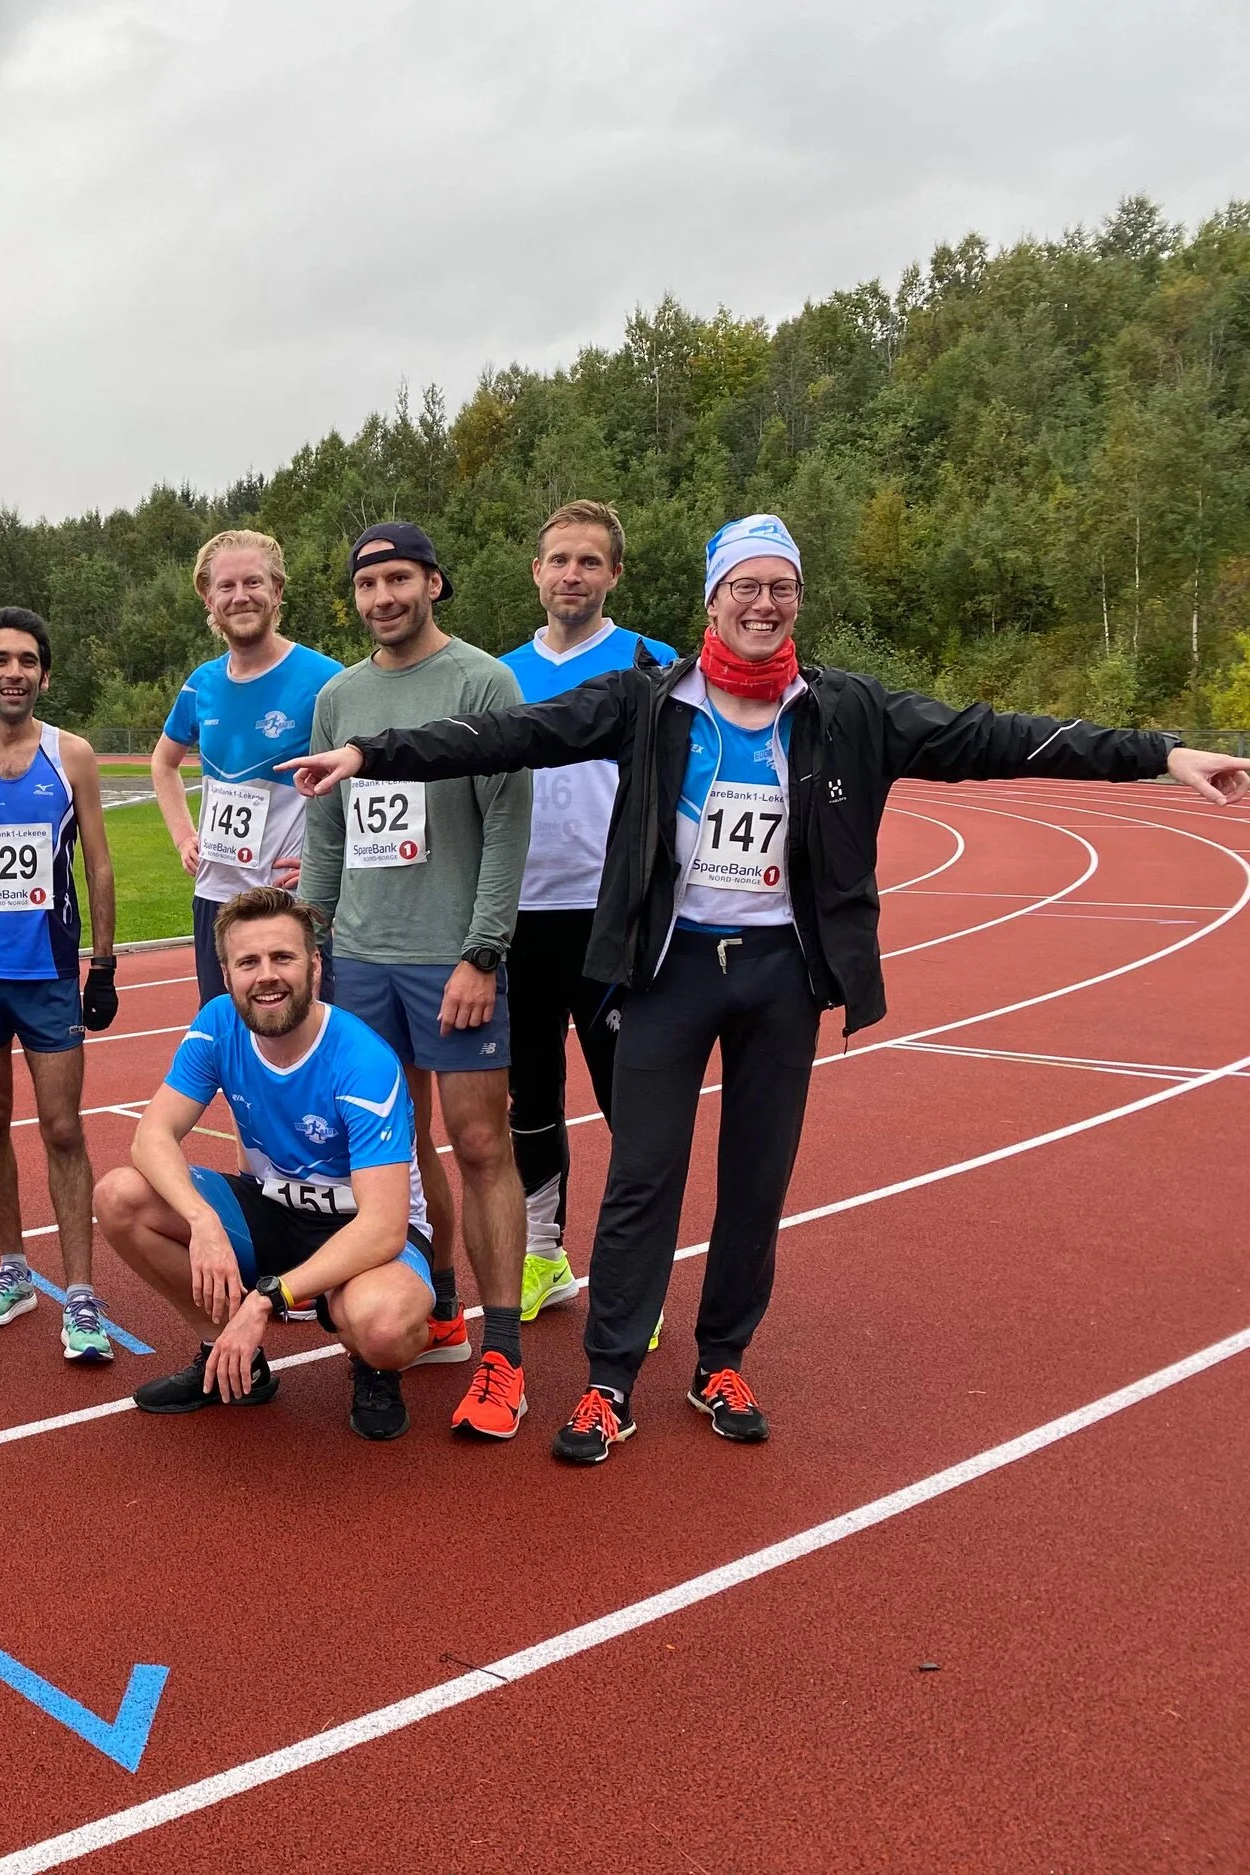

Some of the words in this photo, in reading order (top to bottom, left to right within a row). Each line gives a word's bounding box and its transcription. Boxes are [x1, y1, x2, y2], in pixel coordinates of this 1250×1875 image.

[535, 773, 572, 811] 46
[710, 790, 785, 803] areBank1-Leke
[210, 801, 252, 839] 143
[353, 793, 409, 834] 152
[707, 808, 783, 854] 147
[353, 842, 397, 856] SpareBank
[692, 858, 763, 877] SpareBank
[277, 1182, 340, 1214] 151
